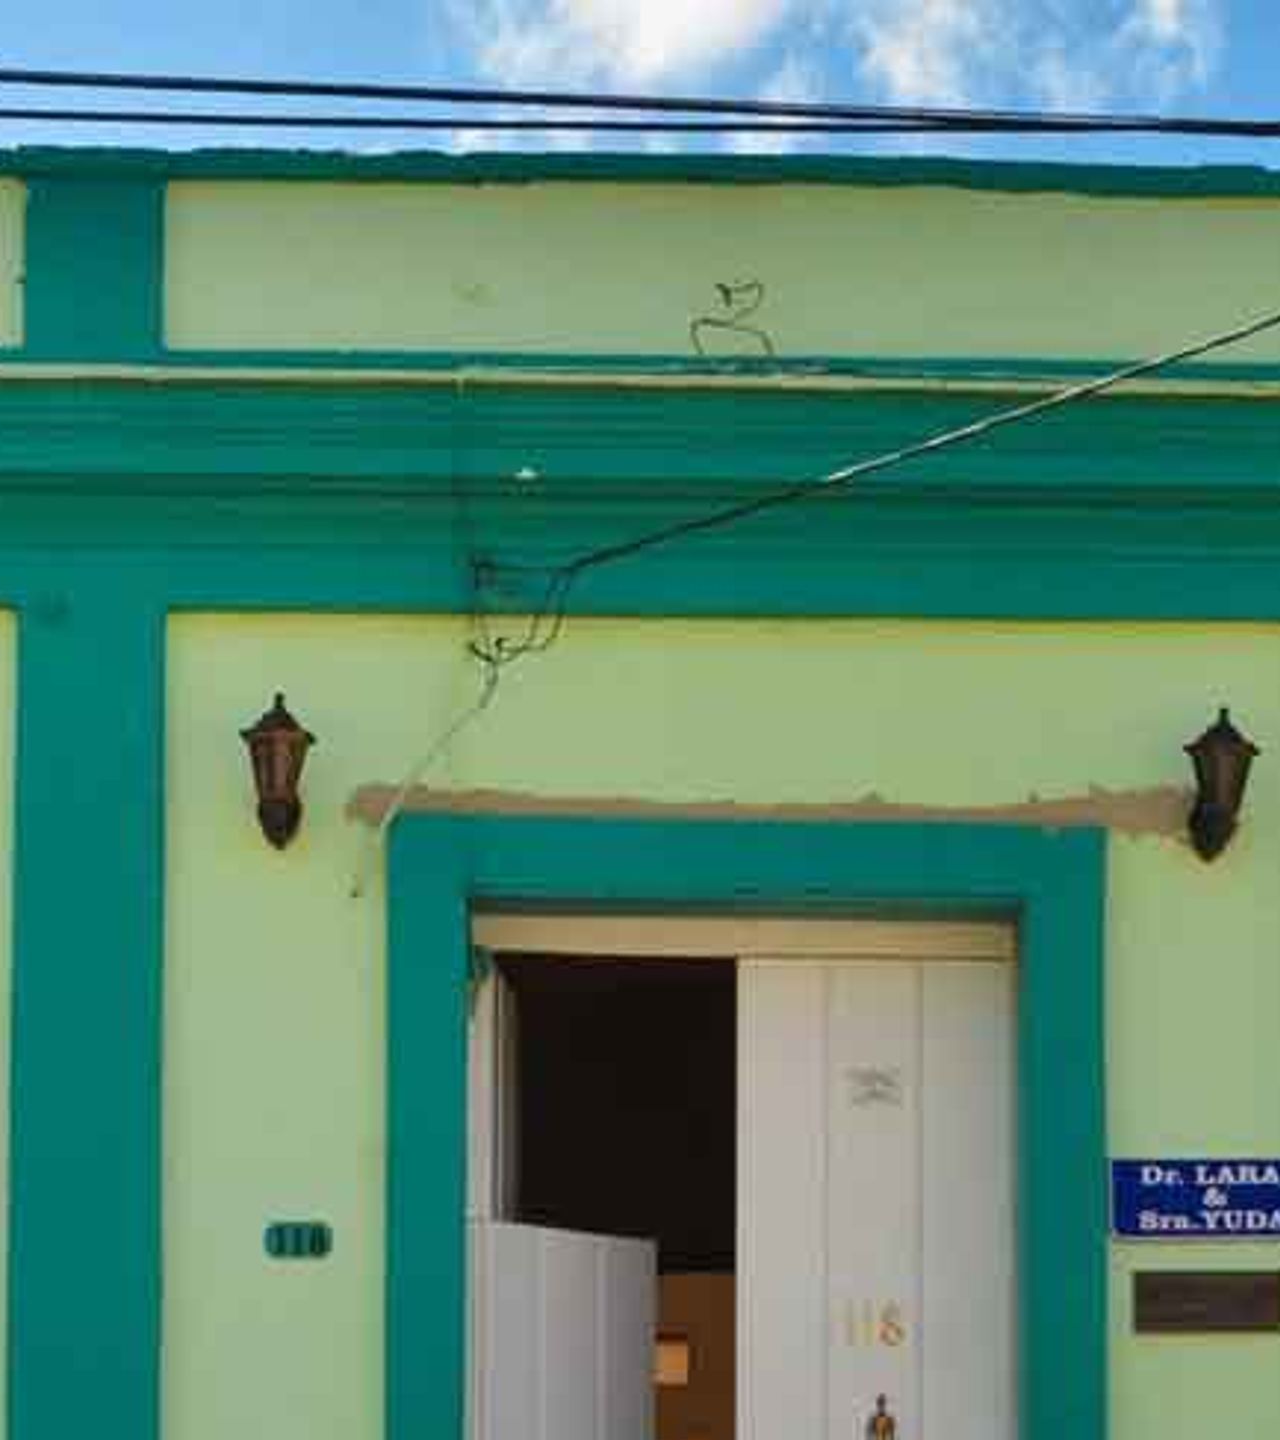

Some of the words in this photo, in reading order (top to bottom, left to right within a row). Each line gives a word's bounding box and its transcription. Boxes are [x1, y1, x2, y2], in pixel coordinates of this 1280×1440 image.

[1142, 1165, 1183, 1185] Dr.
[1196, 1165, 1280, 1185] LARA
[1202, 1186, 1228, 1207] &
